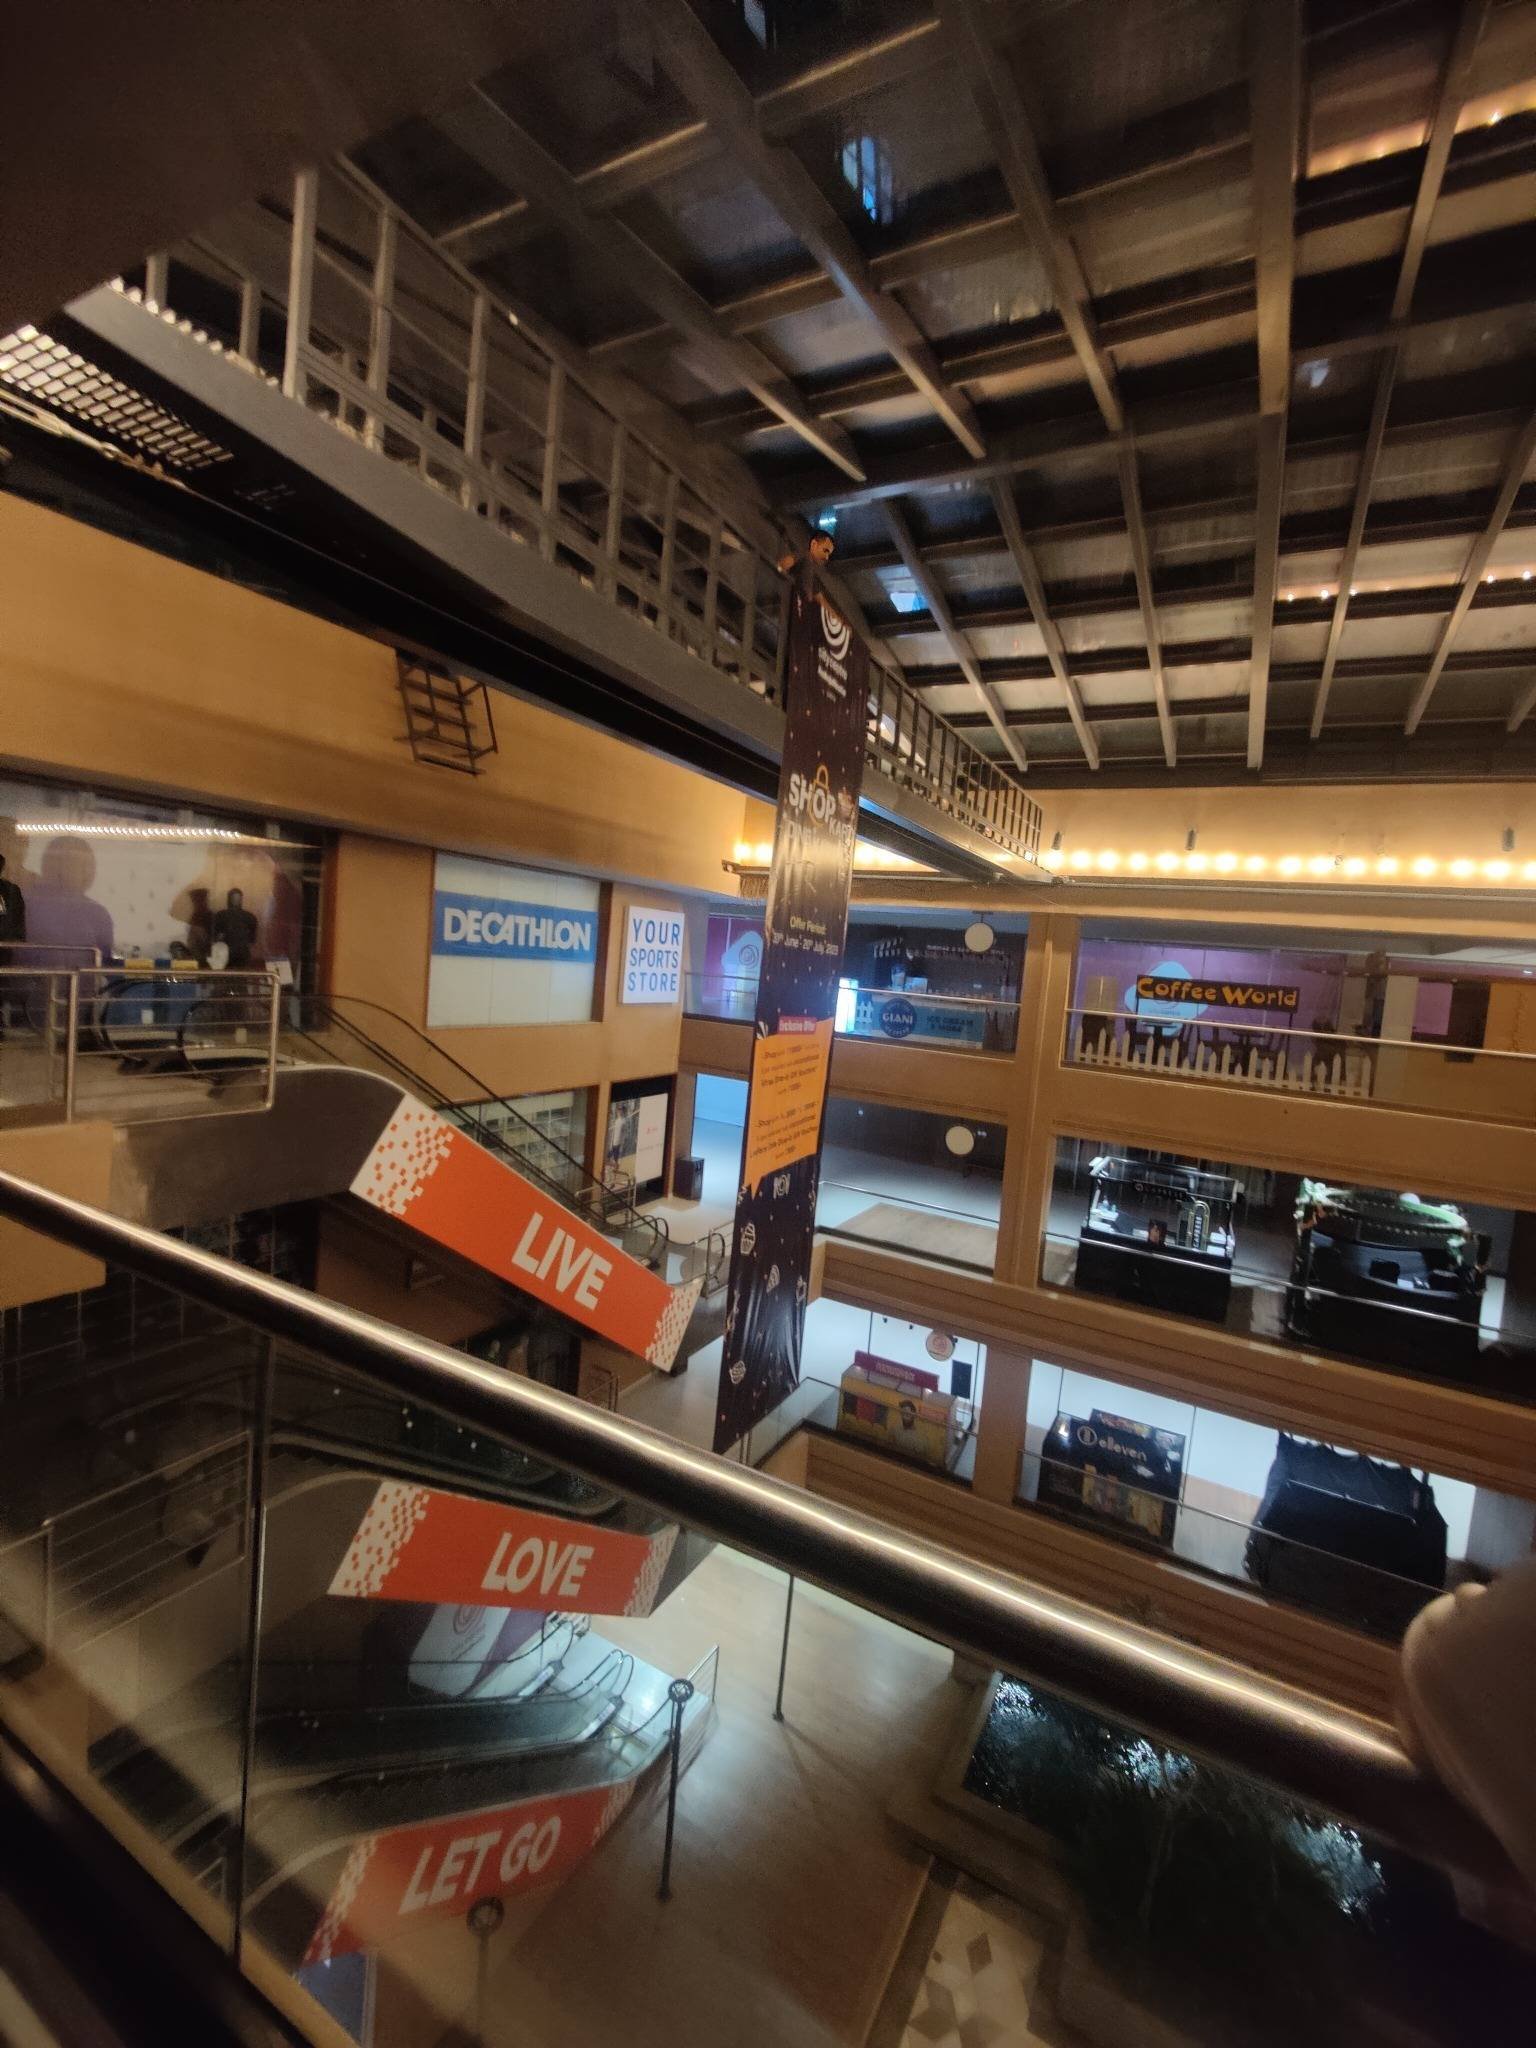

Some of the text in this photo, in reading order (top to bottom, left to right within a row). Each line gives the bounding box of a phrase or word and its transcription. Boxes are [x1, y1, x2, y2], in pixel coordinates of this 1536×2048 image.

[789, 772, 836, 823] SHOP
[443, 907, 591, 951] DECATHLON
[633, 919, 681, 946] YOUR
[630, 948, 679, 969] SPORTS
[627, 972, 677, 992] STORE
[1138, 977, 1297, 1006] Coffee World
[882, 1012, 913, 1024] GIANI
[511, 1212, 612, 1310] LIVE
[481, 1532, 594, 1596] LOVE
[397, 1816, 561, 1914] LET GO
